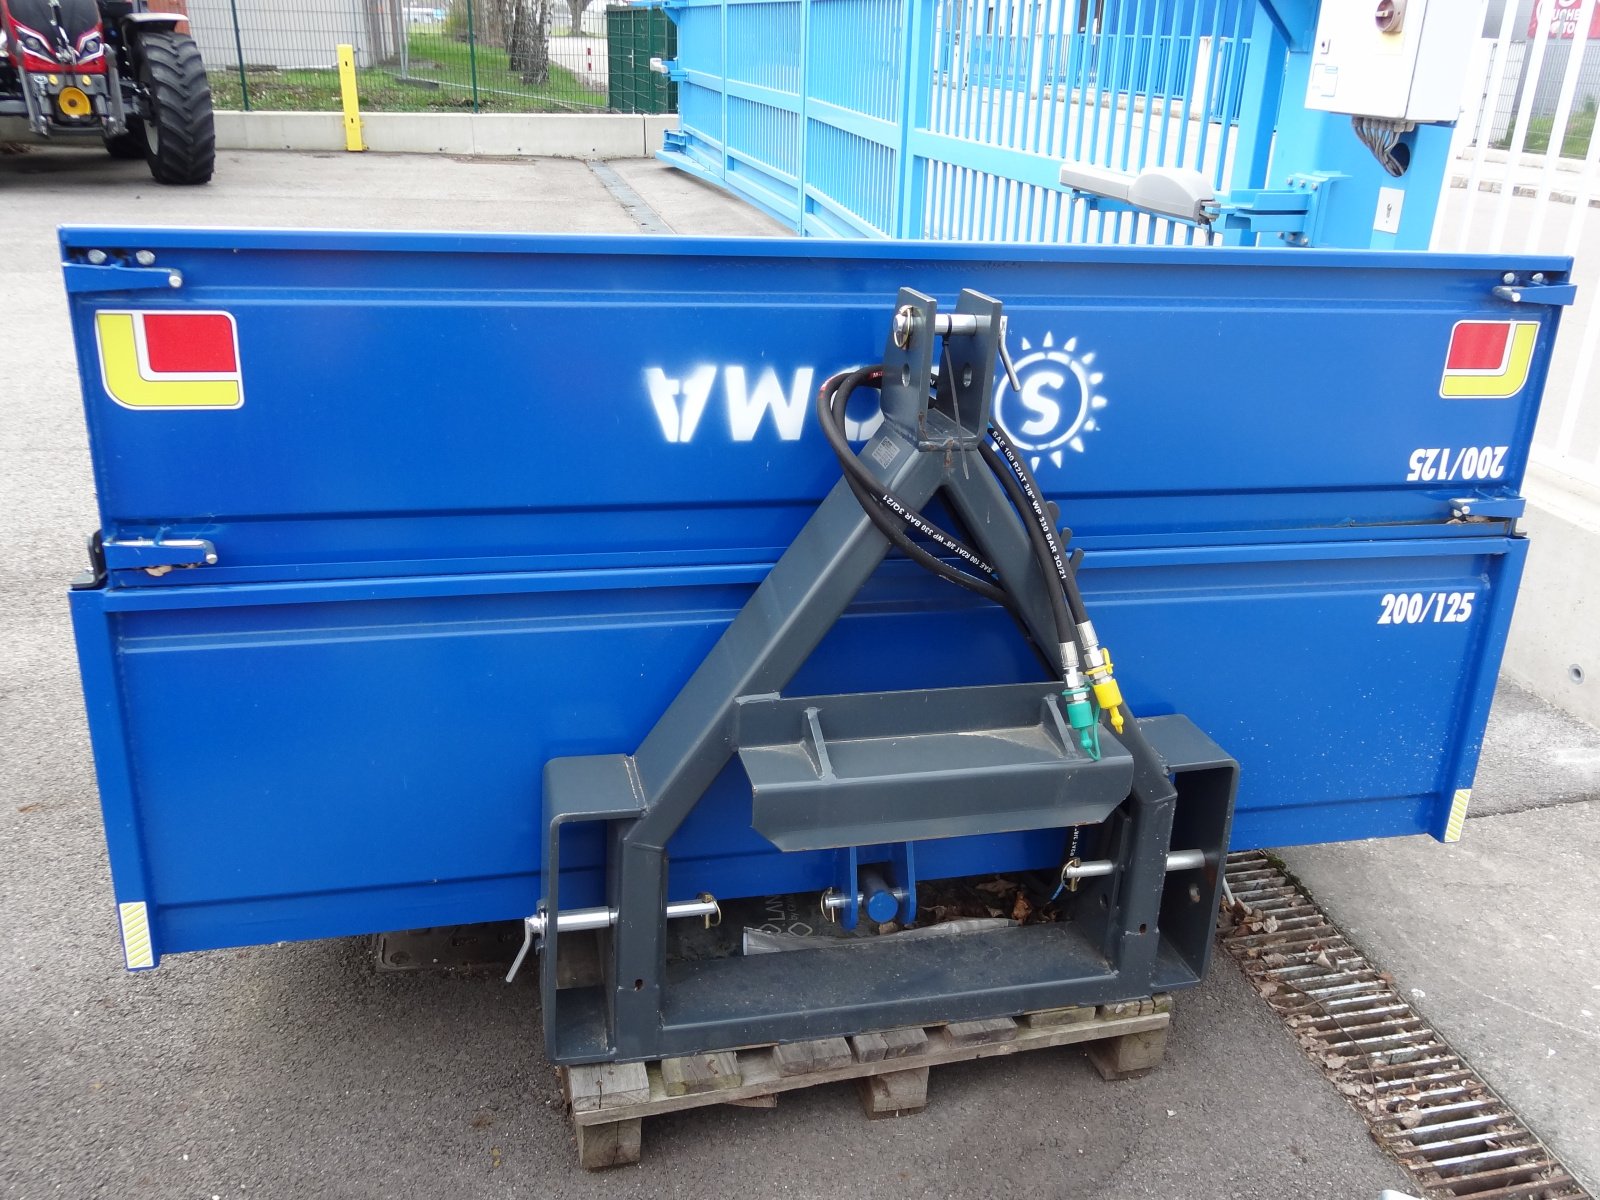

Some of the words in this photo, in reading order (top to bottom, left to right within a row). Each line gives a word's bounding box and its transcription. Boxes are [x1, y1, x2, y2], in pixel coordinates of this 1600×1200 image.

[1406, 446, 1509, 482] 200/125
[882, 494, 905, 515] 3Q/21
[991, 430, 1006, 448] SAE
[1003, 447, 1015, 462] 100
[1012, 460, 1027, 483] R2AT
[1032, 499, 1042, 515] WP
[1038, 516, 1049, 532] 330
[1045, 532, 1058, 554] BAR
[1053, 554, 1067, 580] 3Q/21
[904, 511, 922, 528] BAR
[920, 524, 934, 536] 330
[932, 533, 945, 544] WP
[954, 546, 971, 560] R2AT
[969, 555, 981, 566] 100
[979, 562, 993, 574] SAE
[1377, 592, 1476, 625] 200/125
